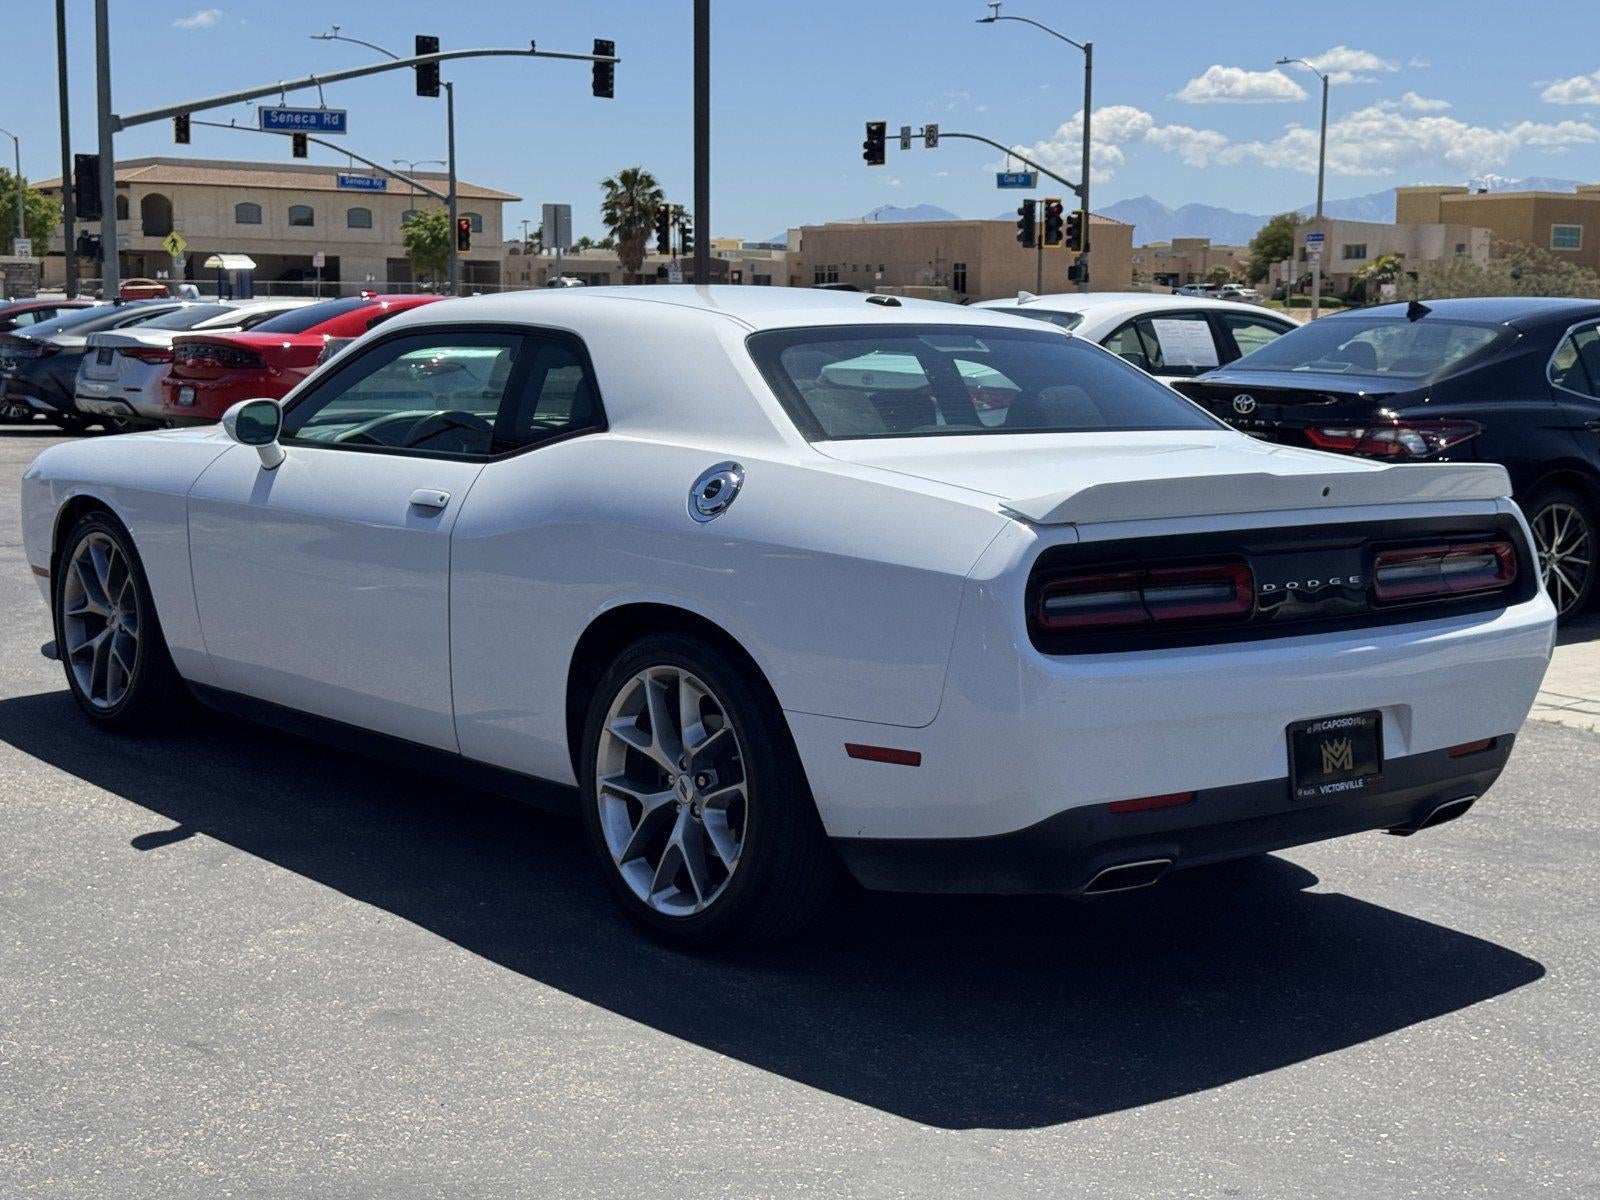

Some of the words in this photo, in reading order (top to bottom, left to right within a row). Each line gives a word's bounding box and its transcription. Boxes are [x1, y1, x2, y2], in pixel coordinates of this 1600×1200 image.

[270, 110, 317, 124] Seneca
[323, 113, 339, 125] Rd
[345, 176, 371, 186] Seneca
[373, 178, 383, 187] Rd
[1222, 417, 1282, 426] AMRY
[1262, 575, 1360, 591] DODGE
[1321, 717, 1353, 730] CAPOSIO
[1320, 779, 1364, 794] VICTORVILLE
